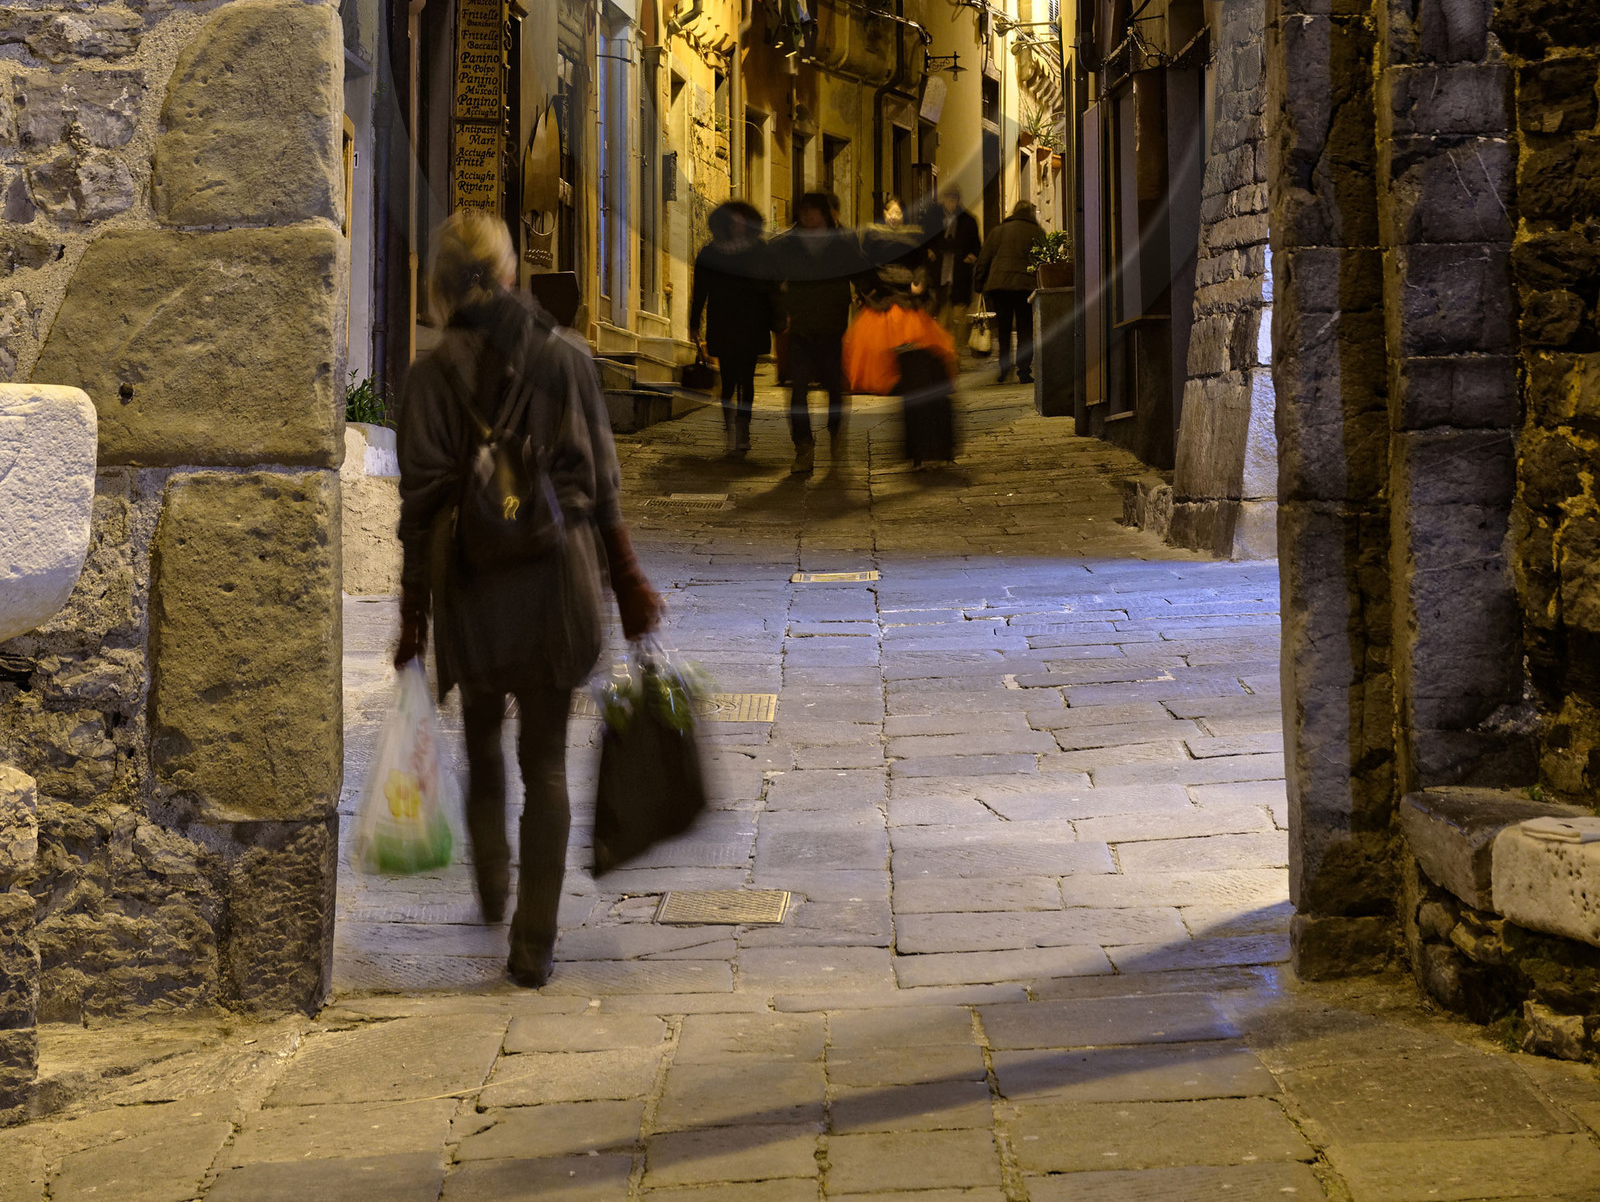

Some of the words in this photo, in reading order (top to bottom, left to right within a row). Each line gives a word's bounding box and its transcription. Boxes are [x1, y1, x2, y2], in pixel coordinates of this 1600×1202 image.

[461, 8, 499, 20] Frittelle
[461, 29, 499, 40] Frittelle
[460, 51, 500, 64] Panino
[472, 63, 496, 73] Polpo
[458, 72, 498, 85] Panino
[465, 85, 498, 96] Muscoli
[457, 94, 498, 107] Panino
[464, 107, 498, 118] Acciughe
[456, 124, 497, 136] Antipasti
[469, 134, 496, 145] Mare
[456, 147, 496, 159] Acciughe
[456, 156, 486, 167] Fritte
[456, 170, 496, 182] Acciughe
[457, 180, 495, 194] Ripiene
[455, 197, 496, 209] Acciughe
